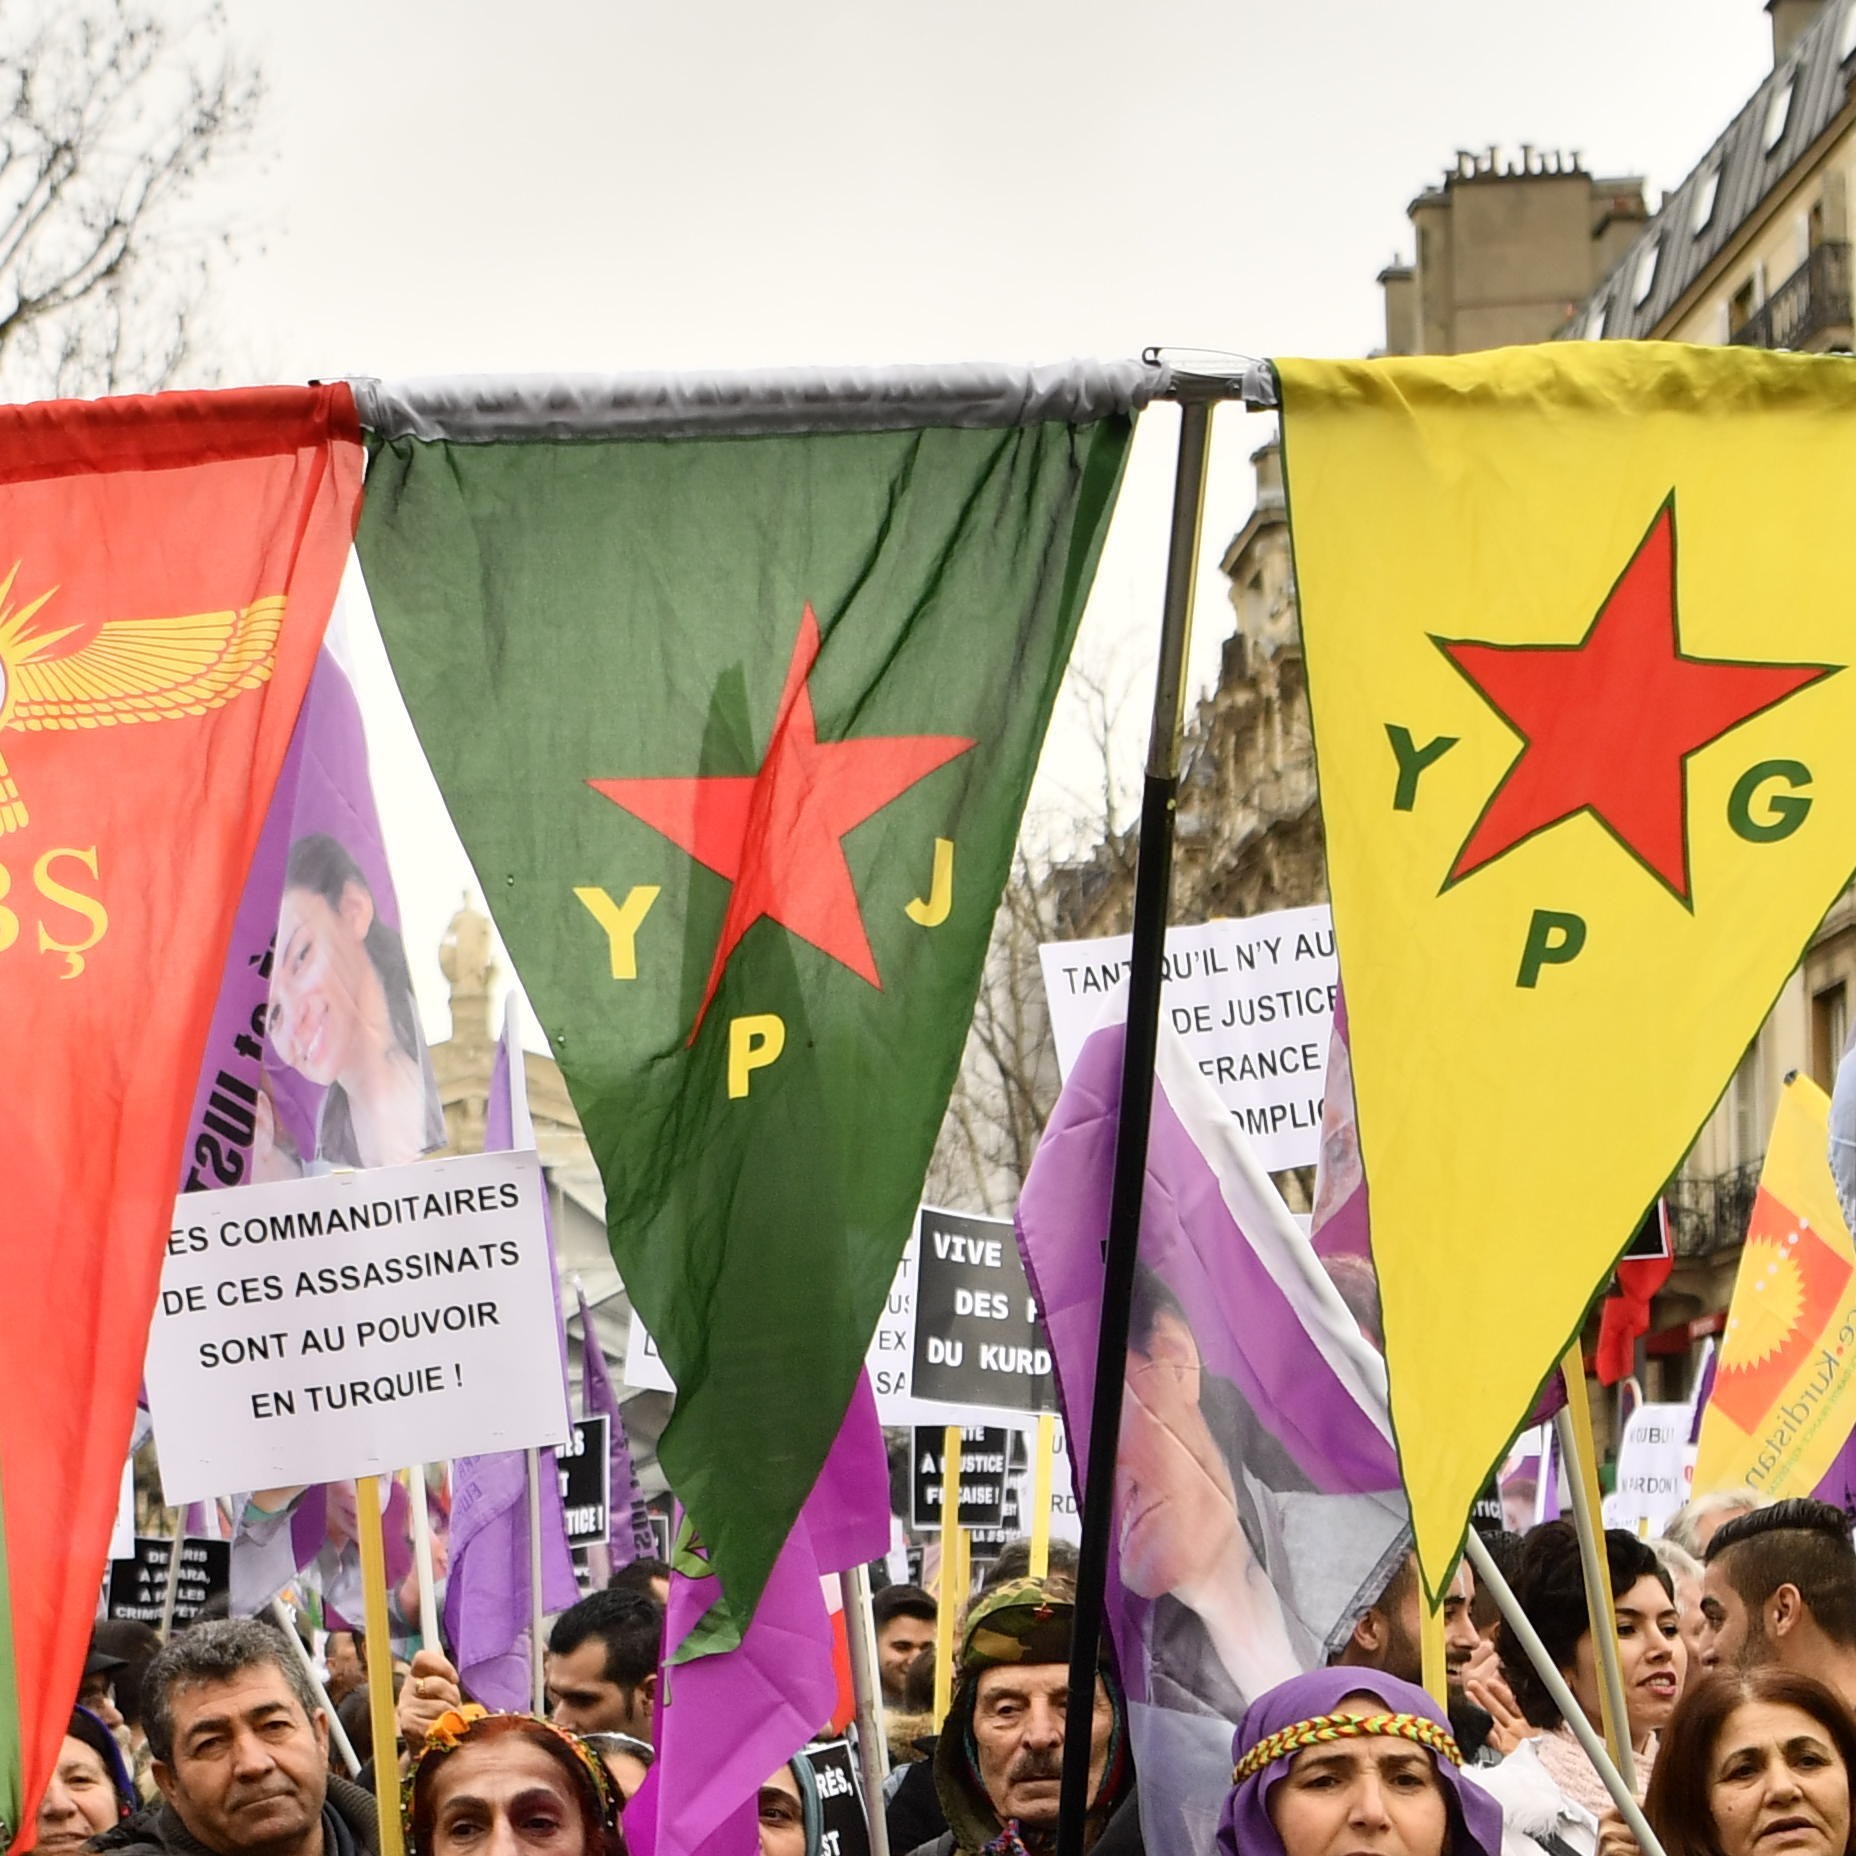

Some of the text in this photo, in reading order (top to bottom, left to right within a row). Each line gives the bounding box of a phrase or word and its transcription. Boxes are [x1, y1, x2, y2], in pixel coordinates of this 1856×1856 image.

[1384, 722, 1461, 812] Y
[1727, 758, 1814, 843] G
[905, 837, 955, 928] J
[573, 885, 661, 980] Y
[1236, 936, 1284, 971] N'Y
[1515, 908, 1587, 989] P
[727, 1014, 786, 1099] P
[1172, 1006, 1213, 1035] DE
[164, 1182, 520, 1257] ES COMMANDITAIRES
[933, 1231, 1002, 1268] VIVE
[162, 1240, 520, 1316] DE CES ASSASSINATS
[954, 1289, 1010, 1319] DES
[198, 1301, 500, 1368] SONT AU POUVOIR
[928, 1337, 963, 1367] DU
[251, 1388, 296, 1419] EN
[304, 1365, 446, 1413] TURQUIE
